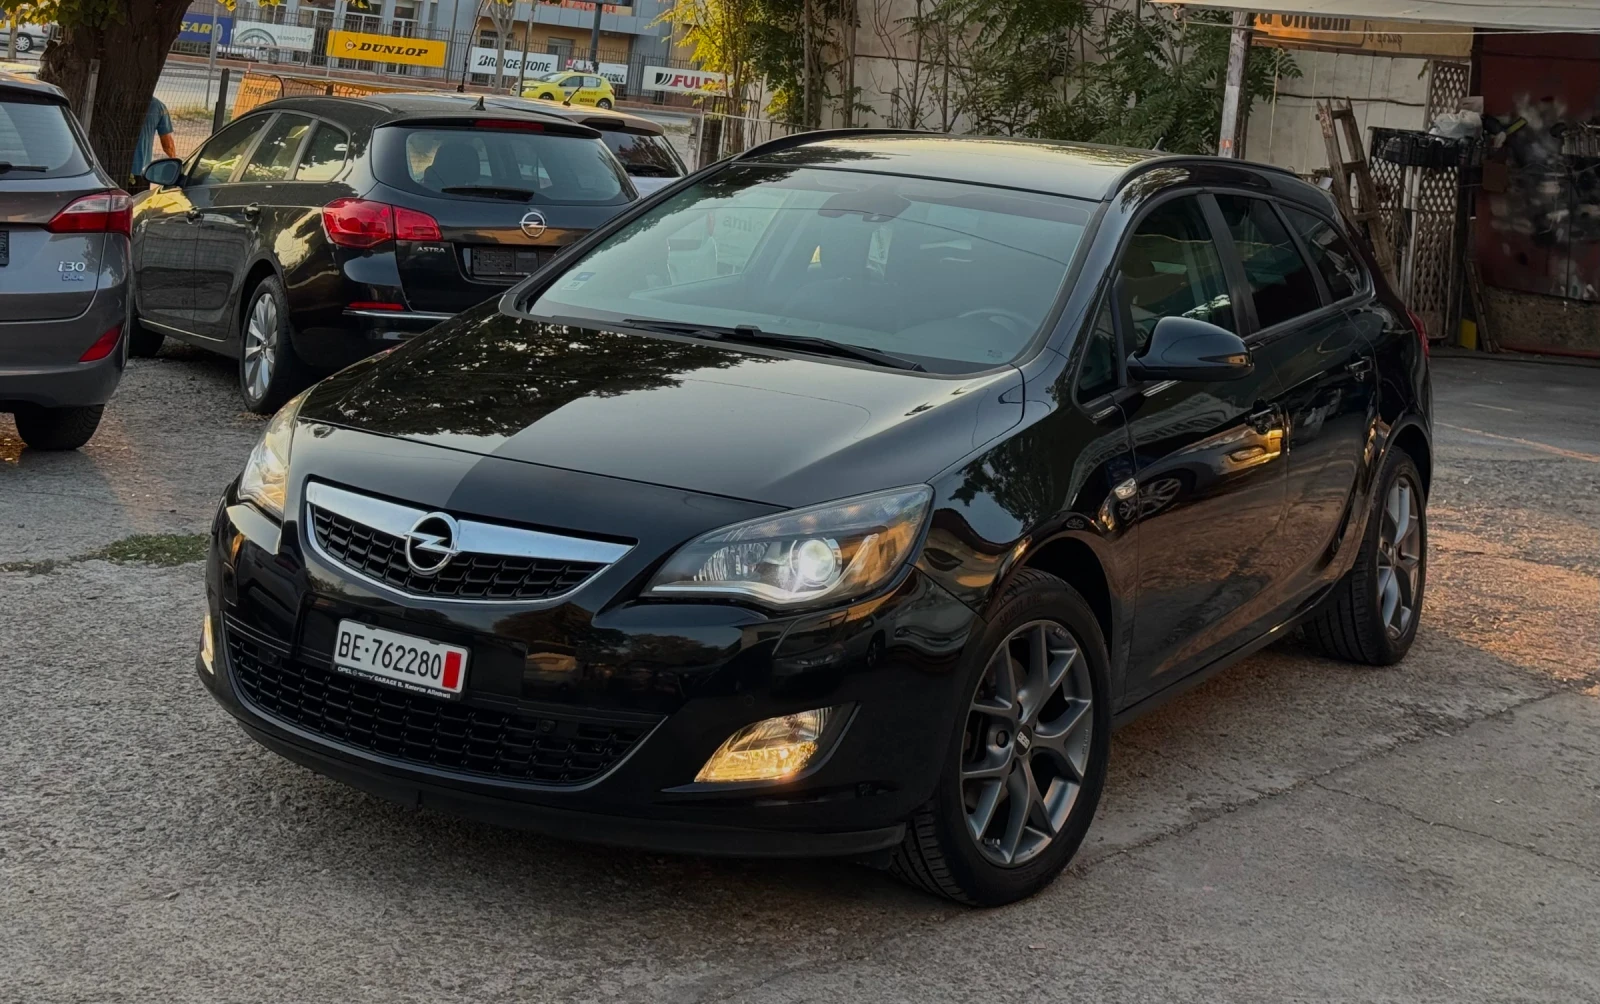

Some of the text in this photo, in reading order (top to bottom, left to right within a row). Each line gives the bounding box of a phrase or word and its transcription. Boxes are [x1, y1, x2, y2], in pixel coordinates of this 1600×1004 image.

[358, 42, 428, 57] DUNLOP
[477, 54, 551, 72] BRGETONE
[58, 260, 86, 272] i30
[337, 666, 352, 675] OPEL
[374, 675, 398, 687] GARAGE
